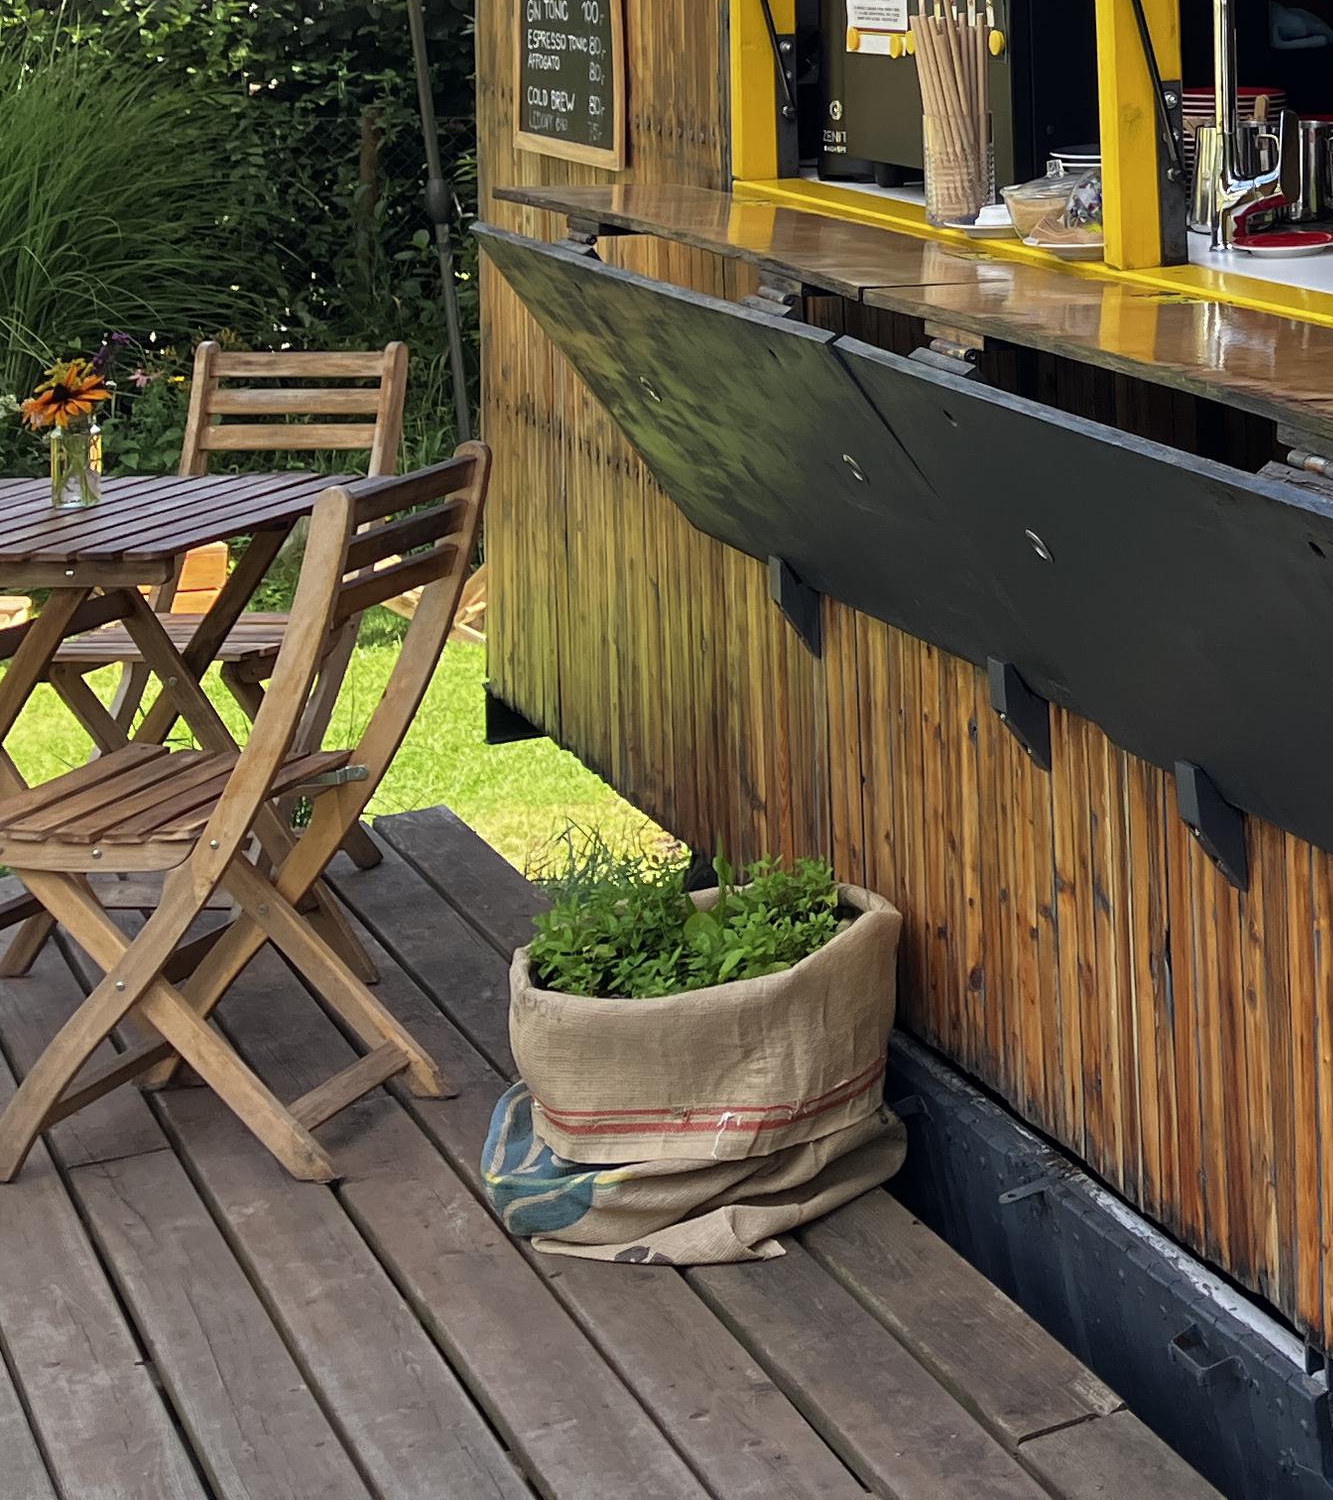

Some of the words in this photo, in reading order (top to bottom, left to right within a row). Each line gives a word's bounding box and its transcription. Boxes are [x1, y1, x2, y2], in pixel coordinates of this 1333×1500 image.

[543, 0, 569, 21] TONIC
[527, 29, 567, 50] ESPRESSO
[528, 53, 560, 71] AFFOGATO
[527, 86, 548, 107] COLD
[550, 89, 576, 112] BREW
